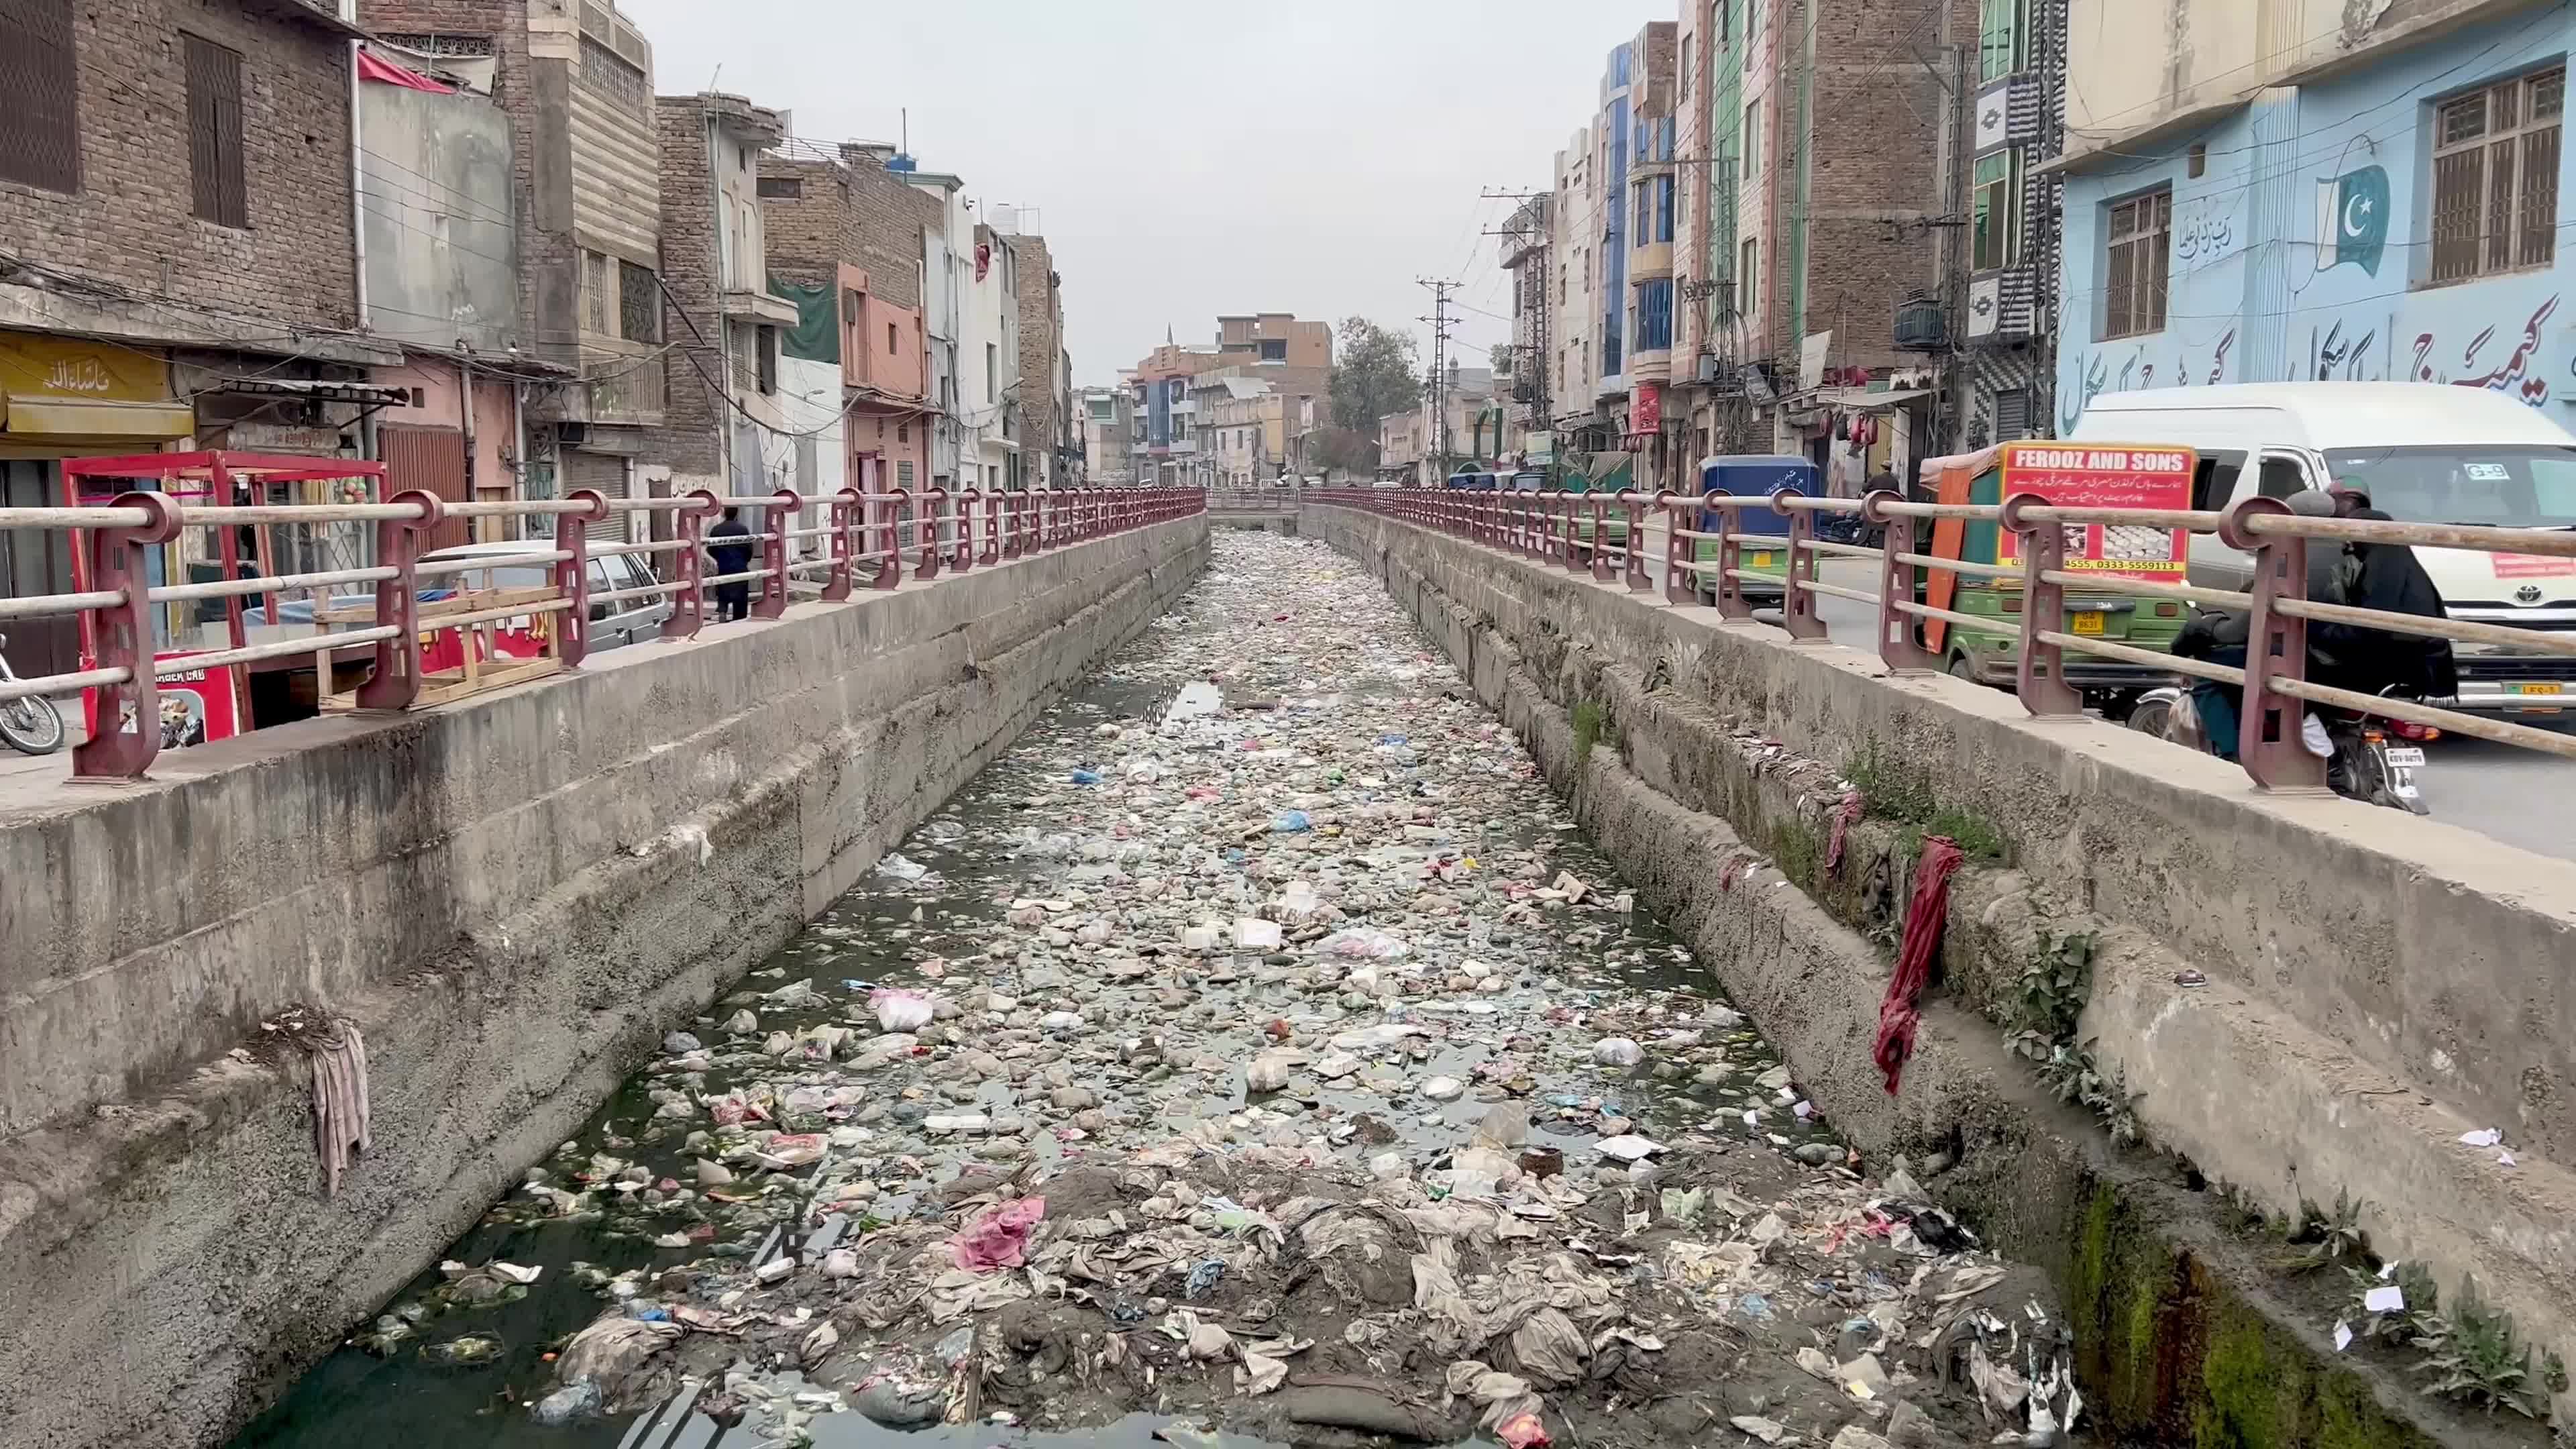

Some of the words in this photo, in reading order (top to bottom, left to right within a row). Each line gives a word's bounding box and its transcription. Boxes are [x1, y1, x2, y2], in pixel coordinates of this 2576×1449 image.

[2016, 450, 2085, 468] FEROOZ
[2087, 451, 2127, 470] AND
[2131, 453, 2184, 471] SONS
[2469, 466, 2504, 477] G-9
